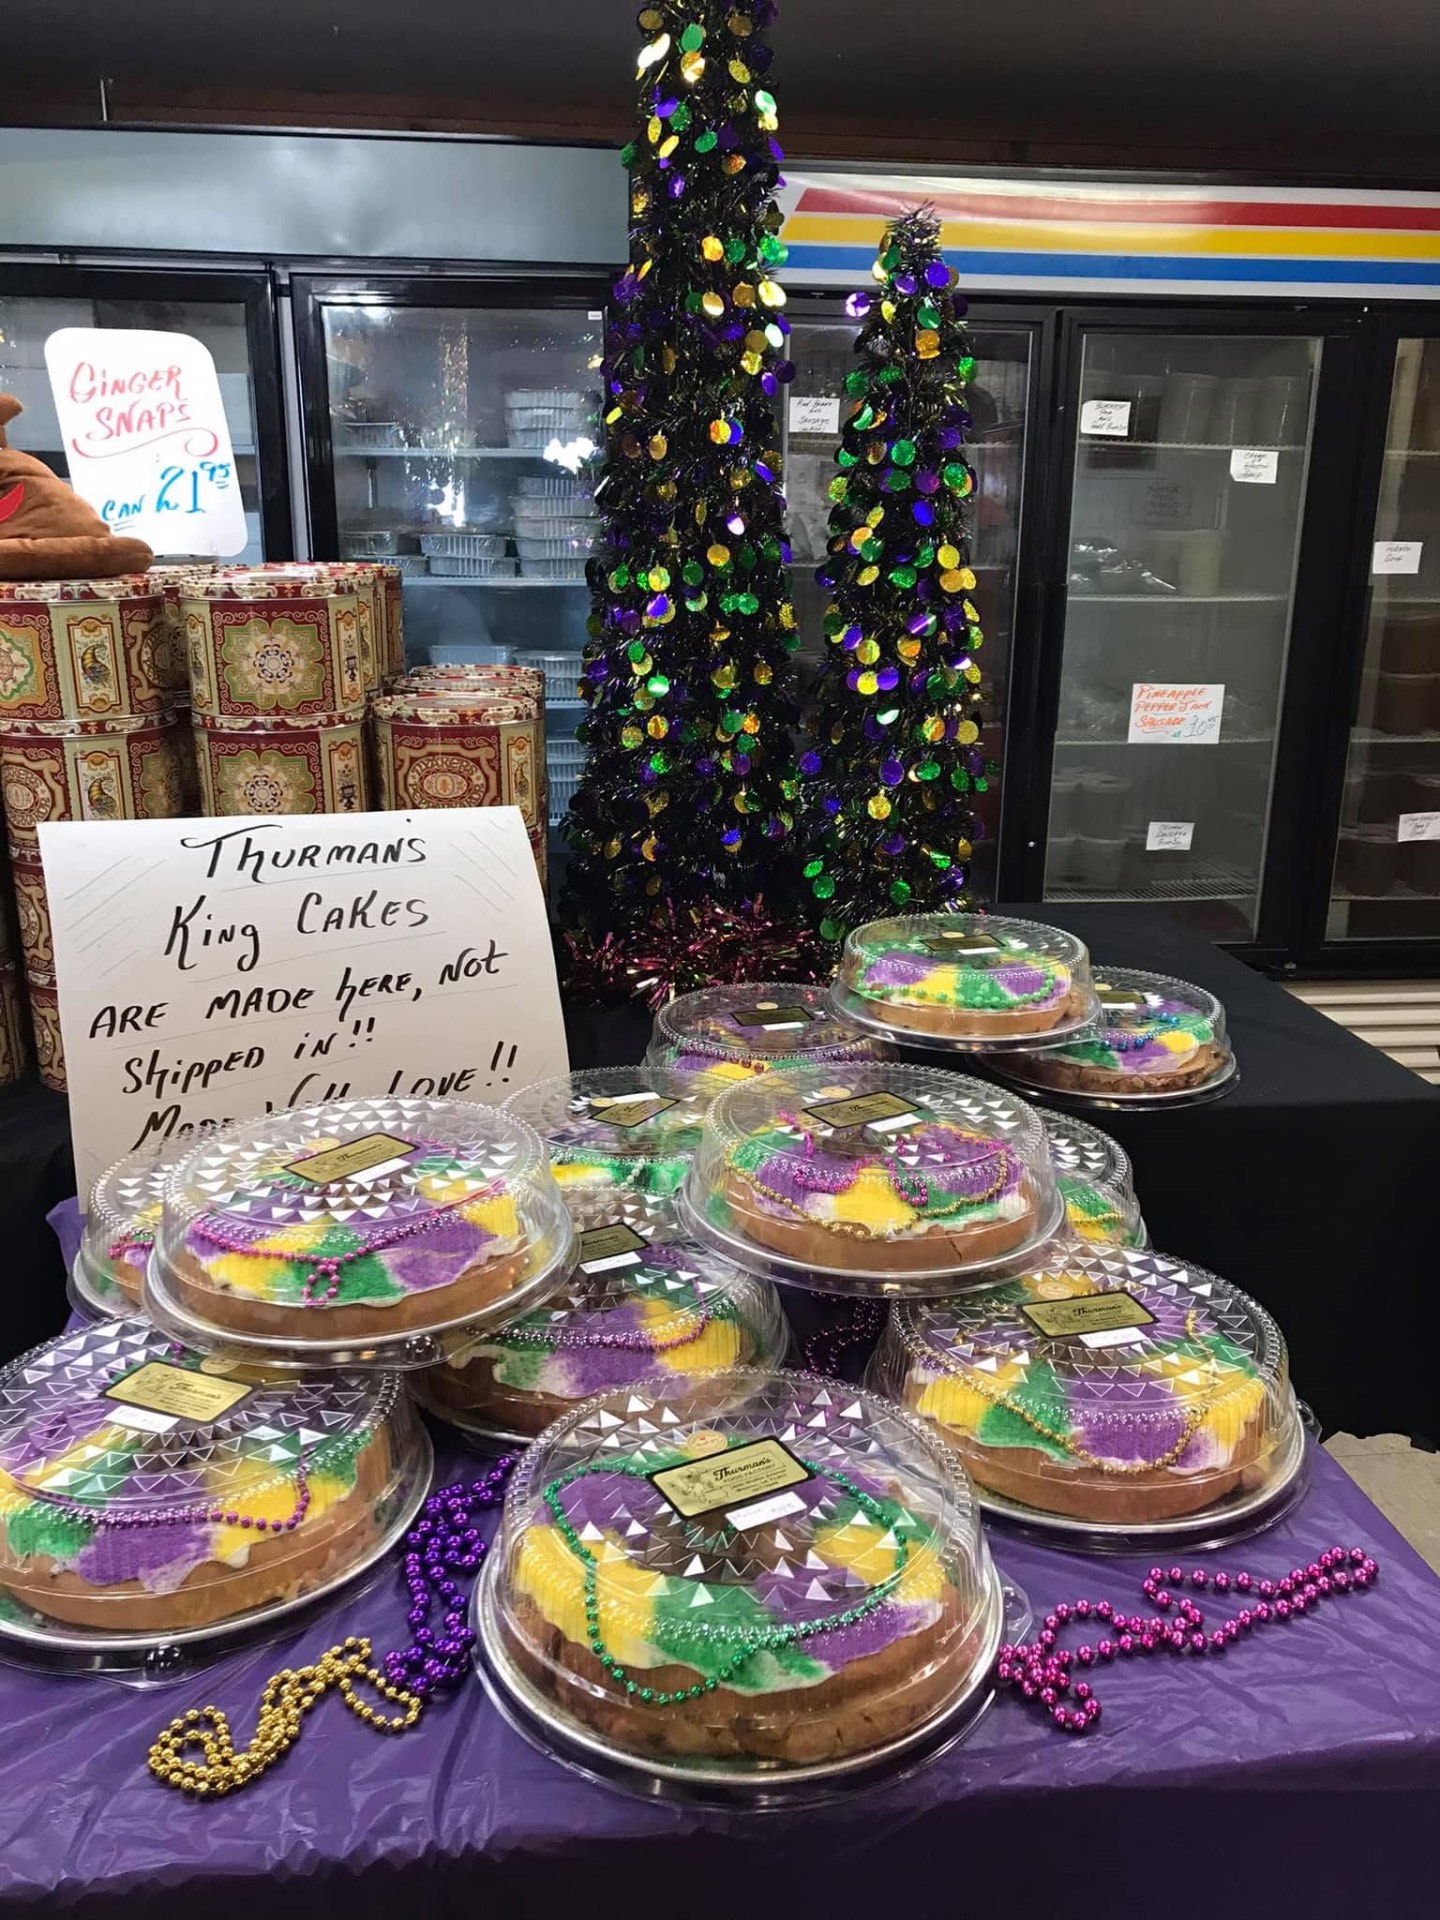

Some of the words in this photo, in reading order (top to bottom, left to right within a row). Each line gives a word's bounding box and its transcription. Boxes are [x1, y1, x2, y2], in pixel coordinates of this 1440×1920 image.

[70, 362, 182, 403] GINGER
[85, 400, 191, 440] SNAPS
[102, 494, 146, 522] CAN
[89, 1002, 168, 1039] ARE
[206, 986, 314, 1020] MADE
[713, 1457, 772, 1481] Thurman's
